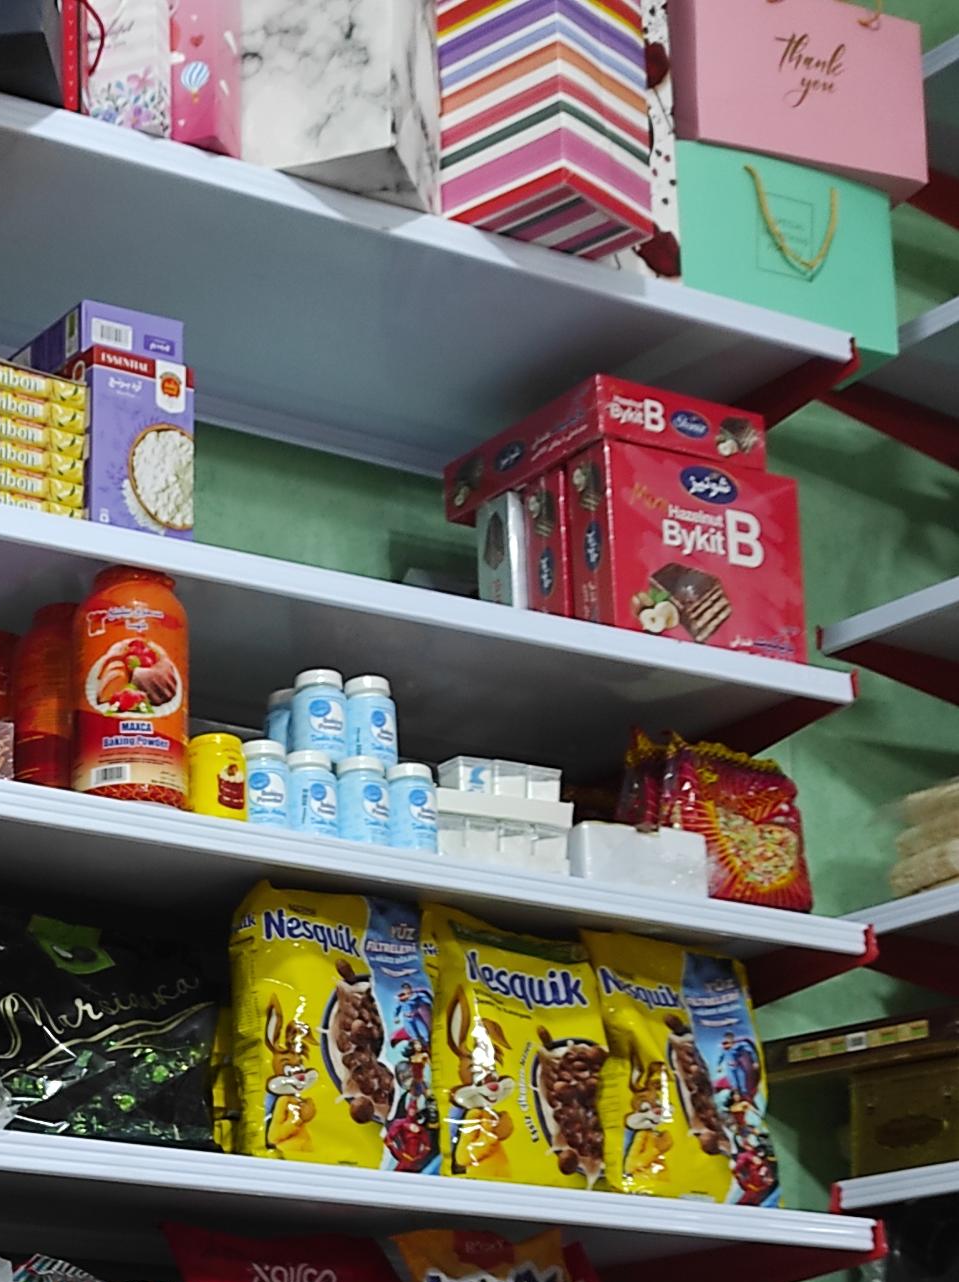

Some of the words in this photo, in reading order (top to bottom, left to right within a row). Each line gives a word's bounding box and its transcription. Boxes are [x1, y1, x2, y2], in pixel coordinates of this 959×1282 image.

[662, 518, 726, 556] Bykit
[726, 508, 766, 569] B
[103, 736, 135, 749] Baking
[137, 737, 170, 750] Powder
[262, 908, 361, 959] Nesquik
[466, 951, 589, 1011] Nesquik
[598, 967, 686, 1010] Nsquik
